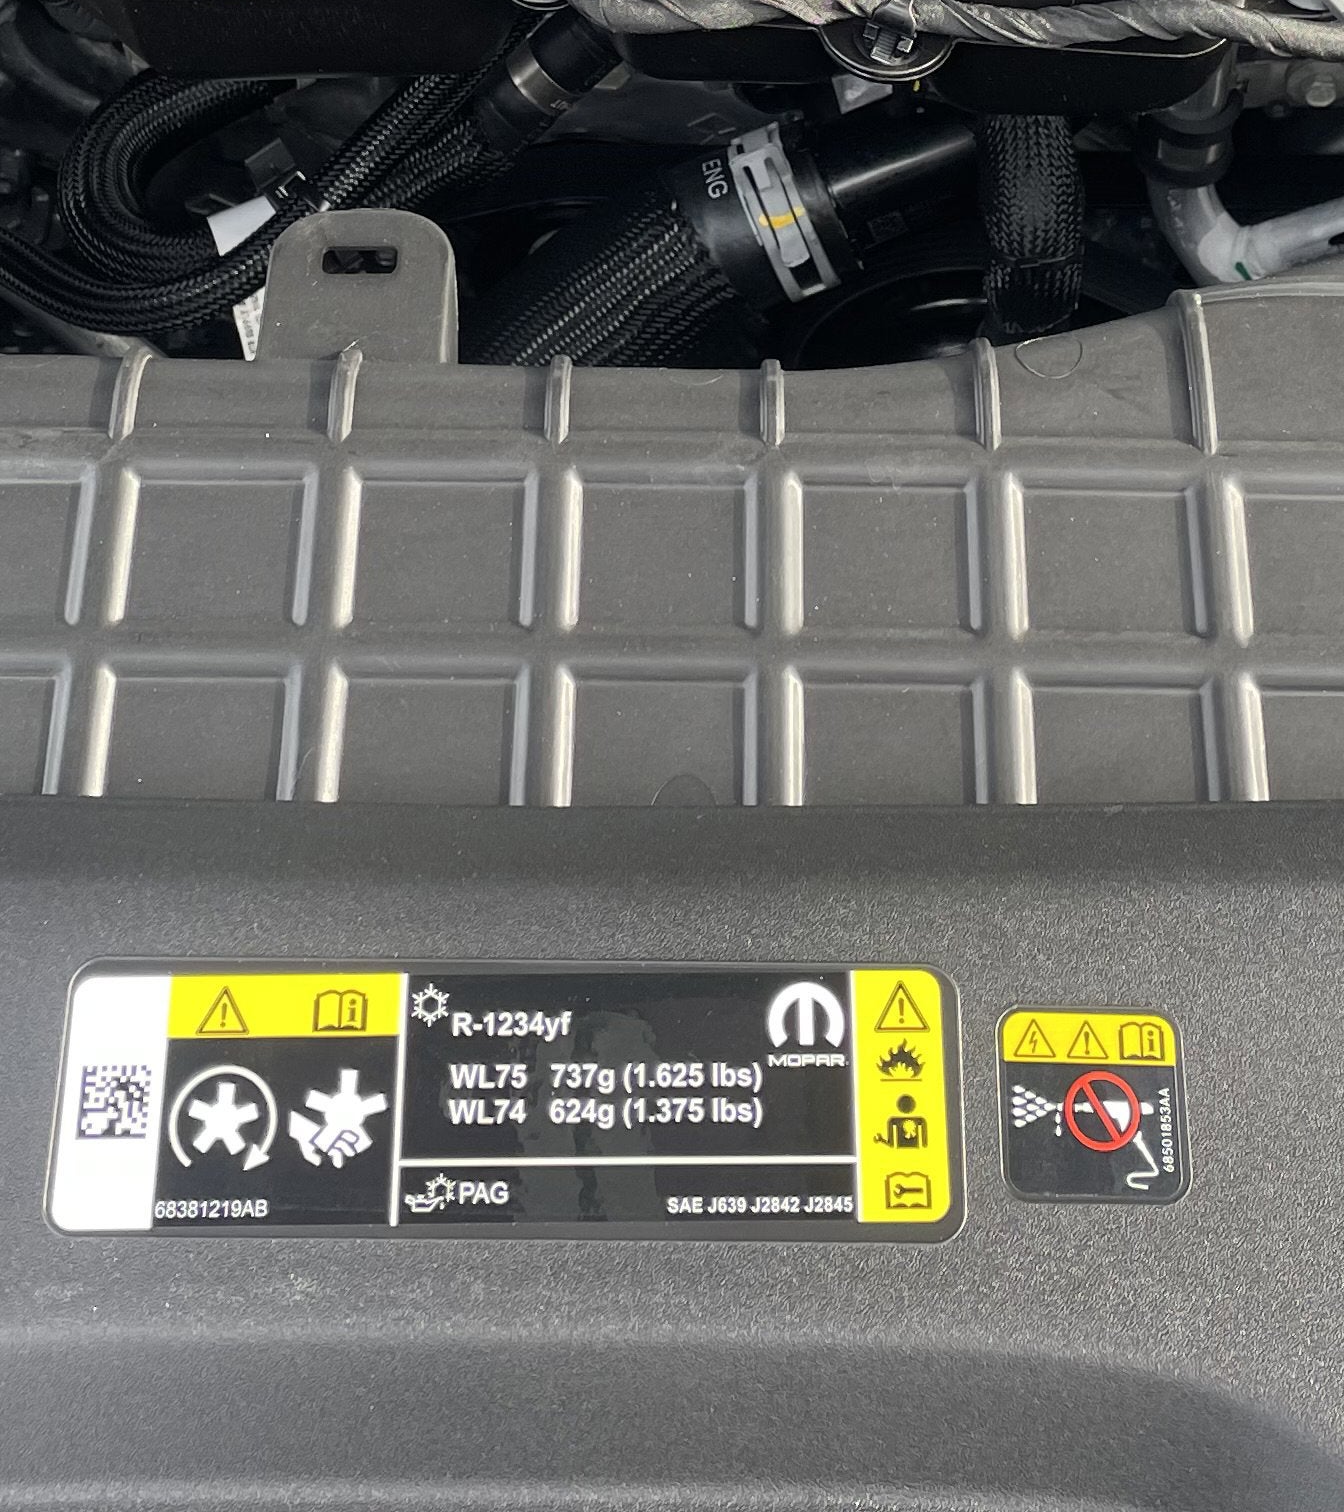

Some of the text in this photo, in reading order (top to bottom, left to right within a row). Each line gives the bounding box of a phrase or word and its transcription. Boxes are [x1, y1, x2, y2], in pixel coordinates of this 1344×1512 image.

[701, 158, 729, 199] ENG
[452, 1011, 573, 1042] R-1234yf
[767, 1053, 846, 1068] MOPAR
[449, 1062, 763, 1095] WL75 737g (1.625 lbs)
[448, 1096, 764, 1130] WL74 624g (1.375 lbs)
[1157, 1087, 1176, 1174] 68501853AA
[457, 1180, 510, 1205] PAG
[666, 1196, 854, 1215] SAE J639 J2842 J2845
[154, 1199, 269, 1219] 68381219AB
